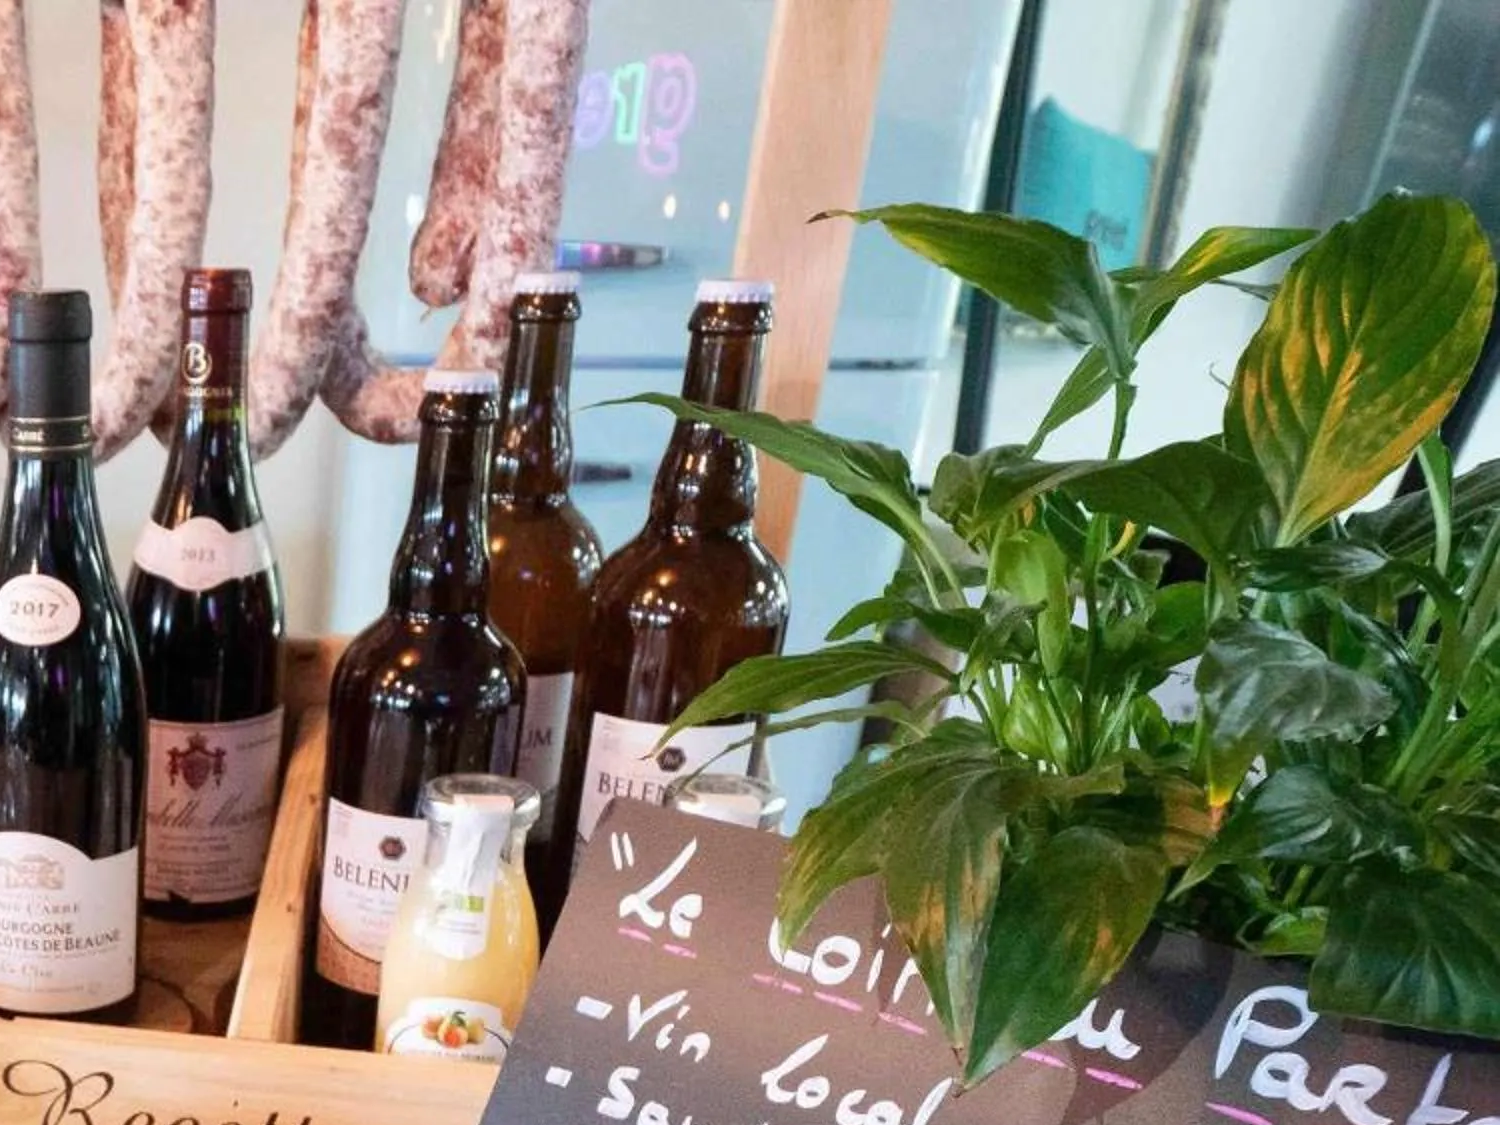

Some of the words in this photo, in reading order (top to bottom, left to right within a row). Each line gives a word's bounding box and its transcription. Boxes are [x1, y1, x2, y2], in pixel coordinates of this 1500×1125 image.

[9, 599, 61, 619] 2017
[43, 937, 62, 953] DE
[65, 926, 122, 952] BEAUNE
